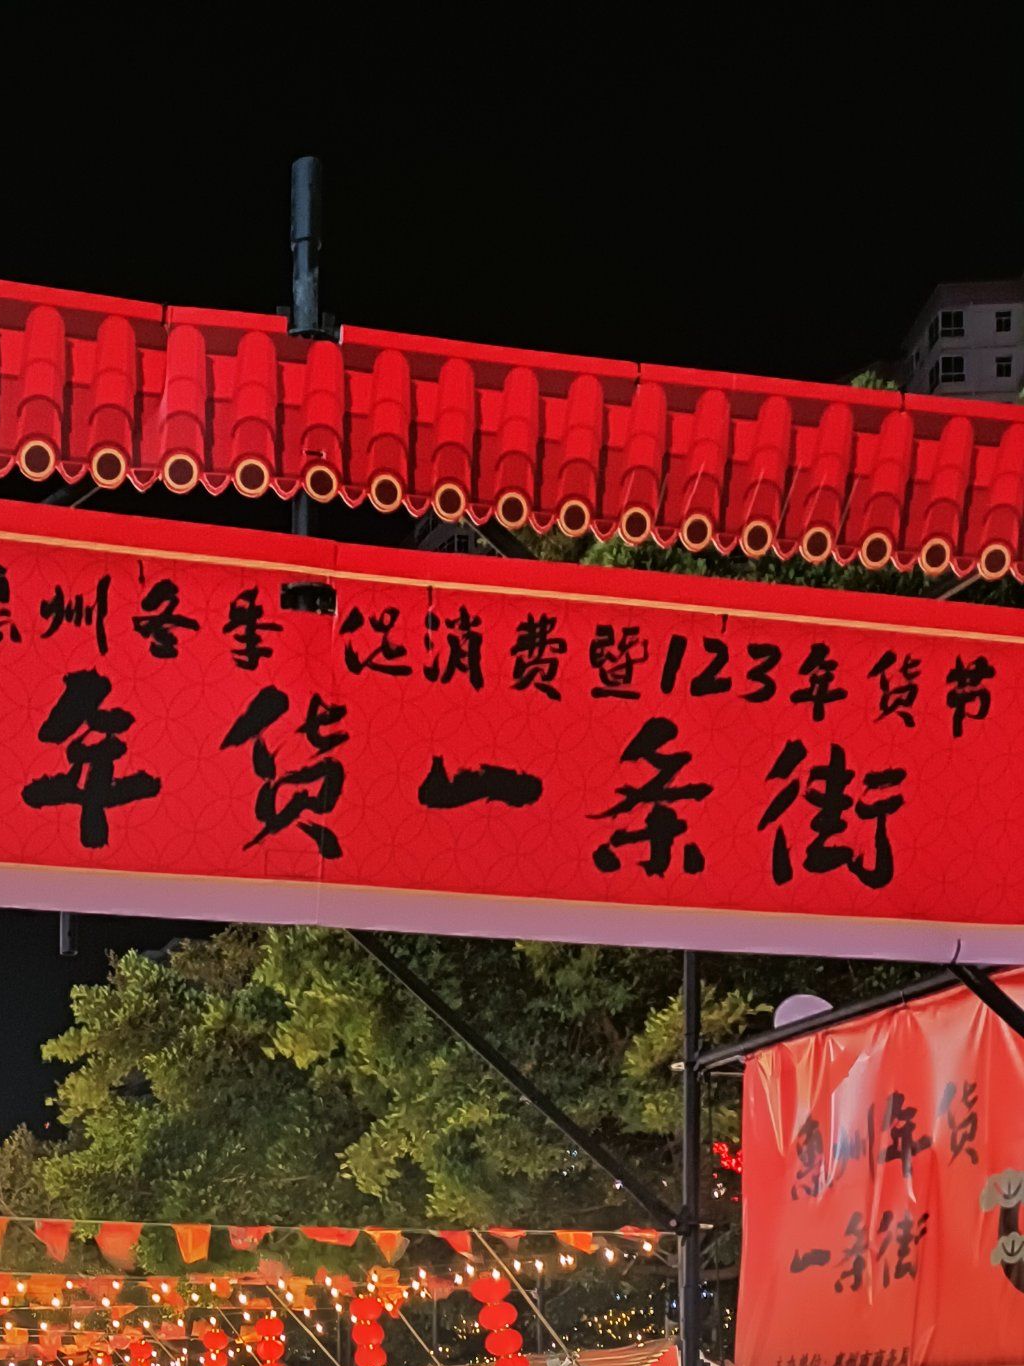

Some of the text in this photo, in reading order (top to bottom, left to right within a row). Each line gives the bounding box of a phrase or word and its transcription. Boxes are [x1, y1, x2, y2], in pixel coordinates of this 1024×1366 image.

[791, 1080, 980, 1200] 惠州年货
[790, 1210, 930, 1293] 一条街
